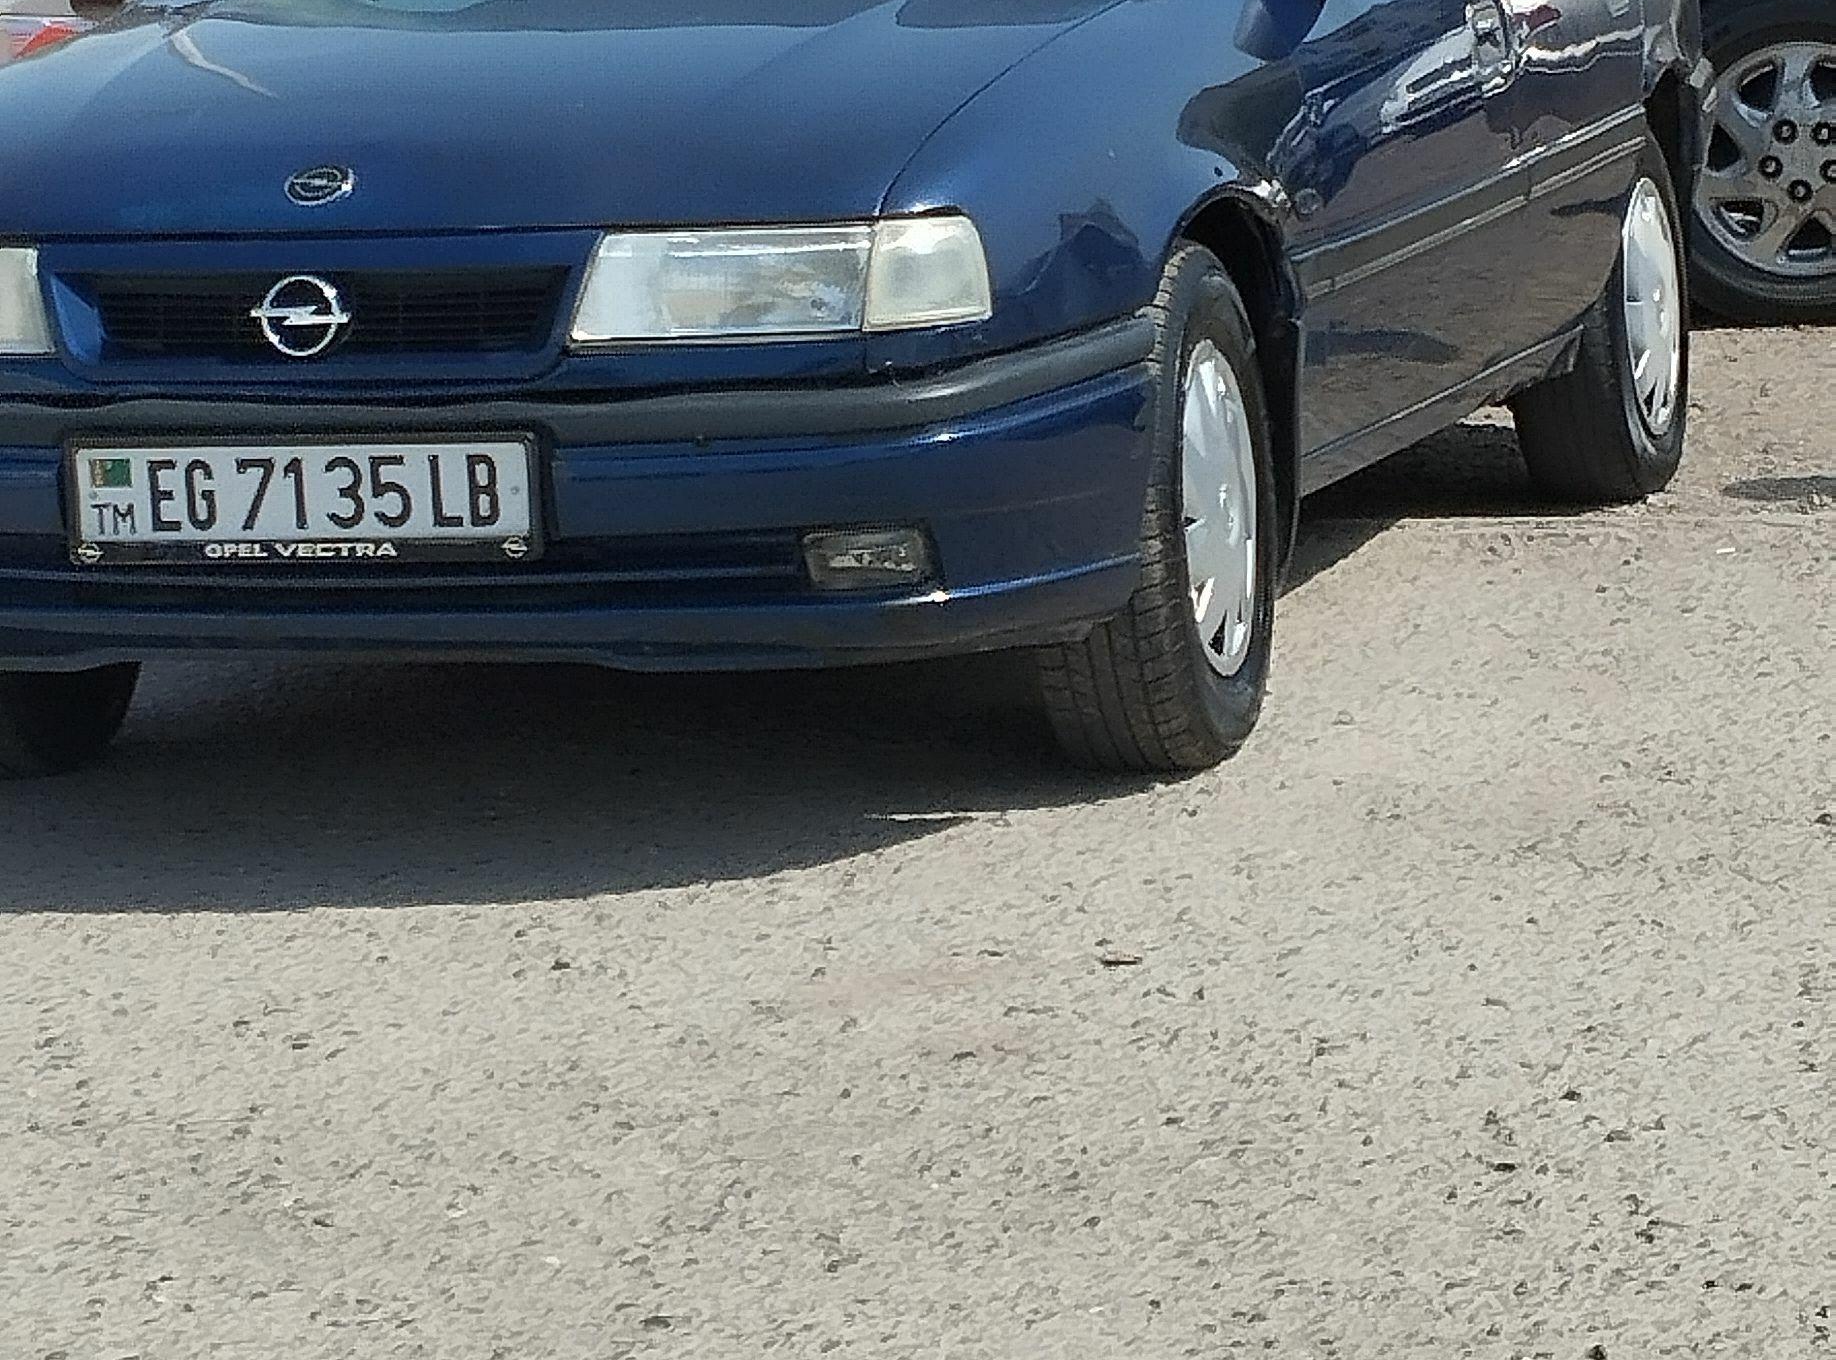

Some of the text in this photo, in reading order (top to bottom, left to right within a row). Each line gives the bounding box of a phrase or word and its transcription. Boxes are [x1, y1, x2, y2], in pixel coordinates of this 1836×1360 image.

[146, 457, 218, 533] EG
[428, 453, 500, 529] LB
[90, 501, 138, 536] TM
[204, 542, 399, 559] OPEL VECTRA
